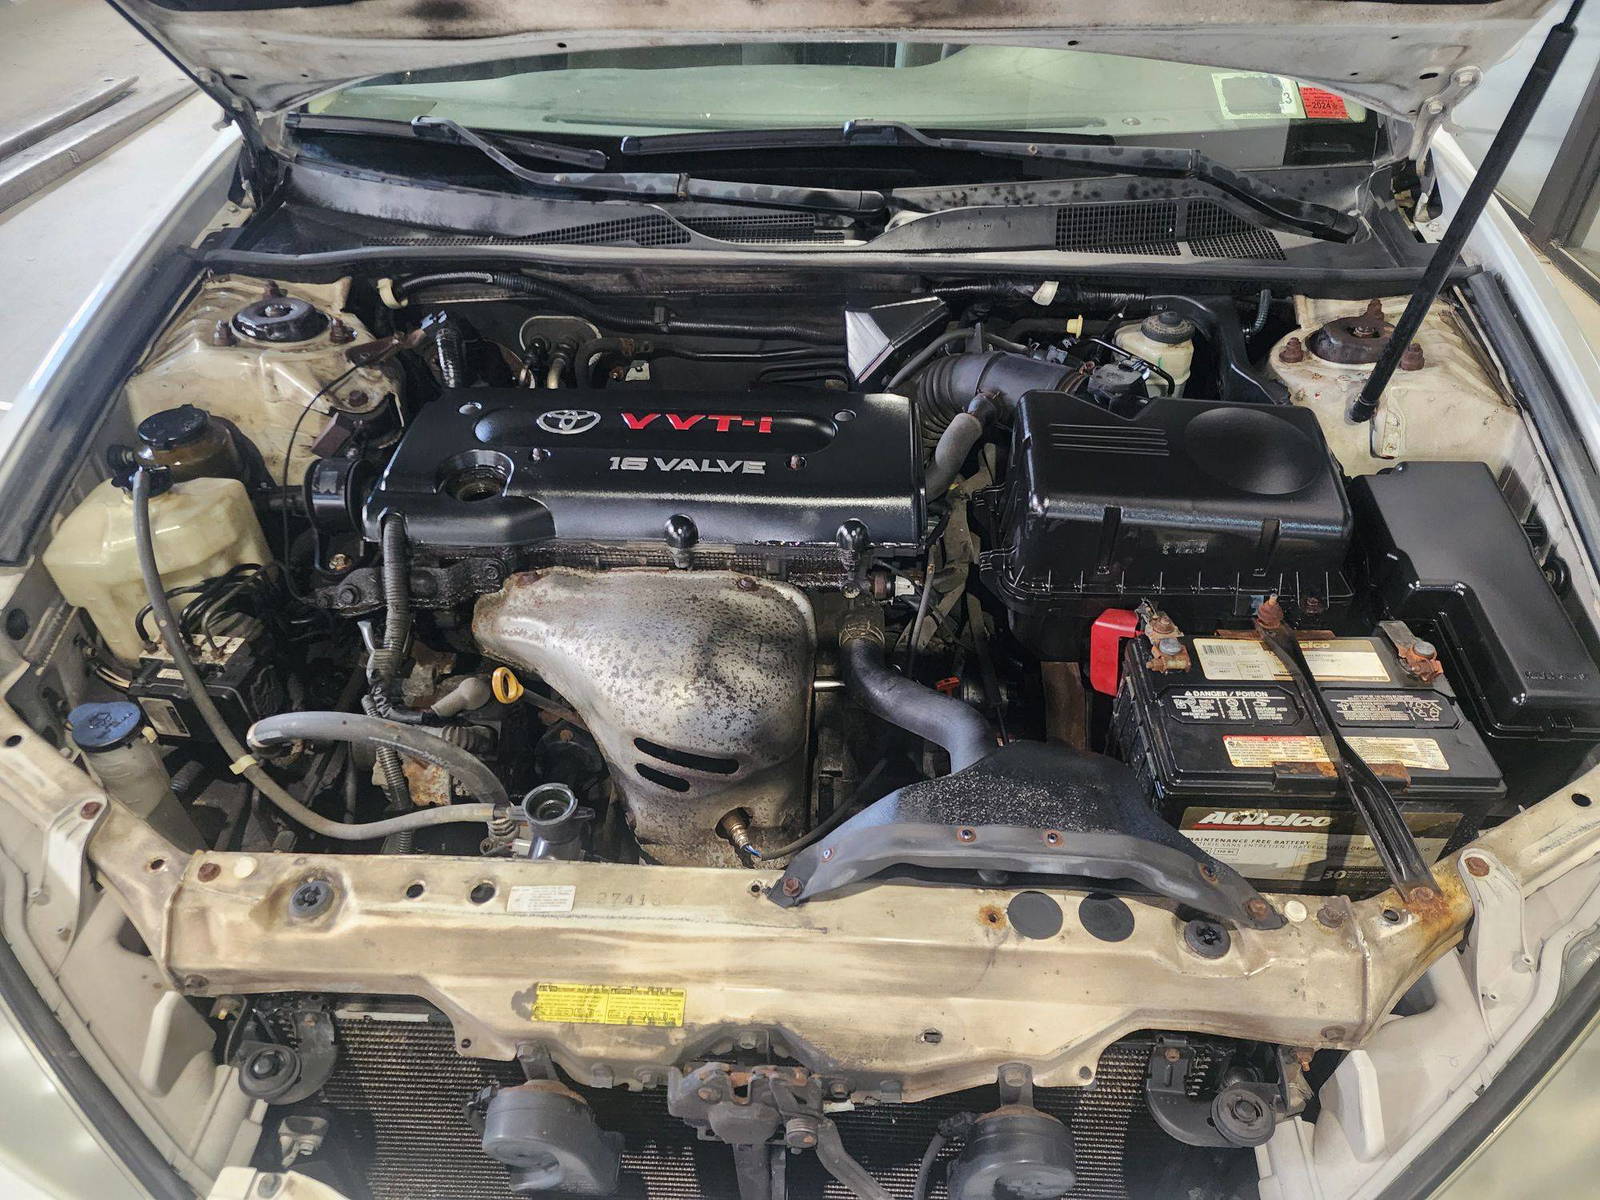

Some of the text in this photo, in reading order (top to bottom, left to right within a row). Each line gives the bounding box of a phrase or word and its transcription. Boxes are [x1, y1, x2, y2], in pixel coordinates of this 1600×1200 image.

[609, 456, 766, 474] 16 VALVE
[1235, 690, 1269, 698] POISON
[1198, 811, 1332, 827] ACDelco
[1323, 870, 1347, 880] 30
